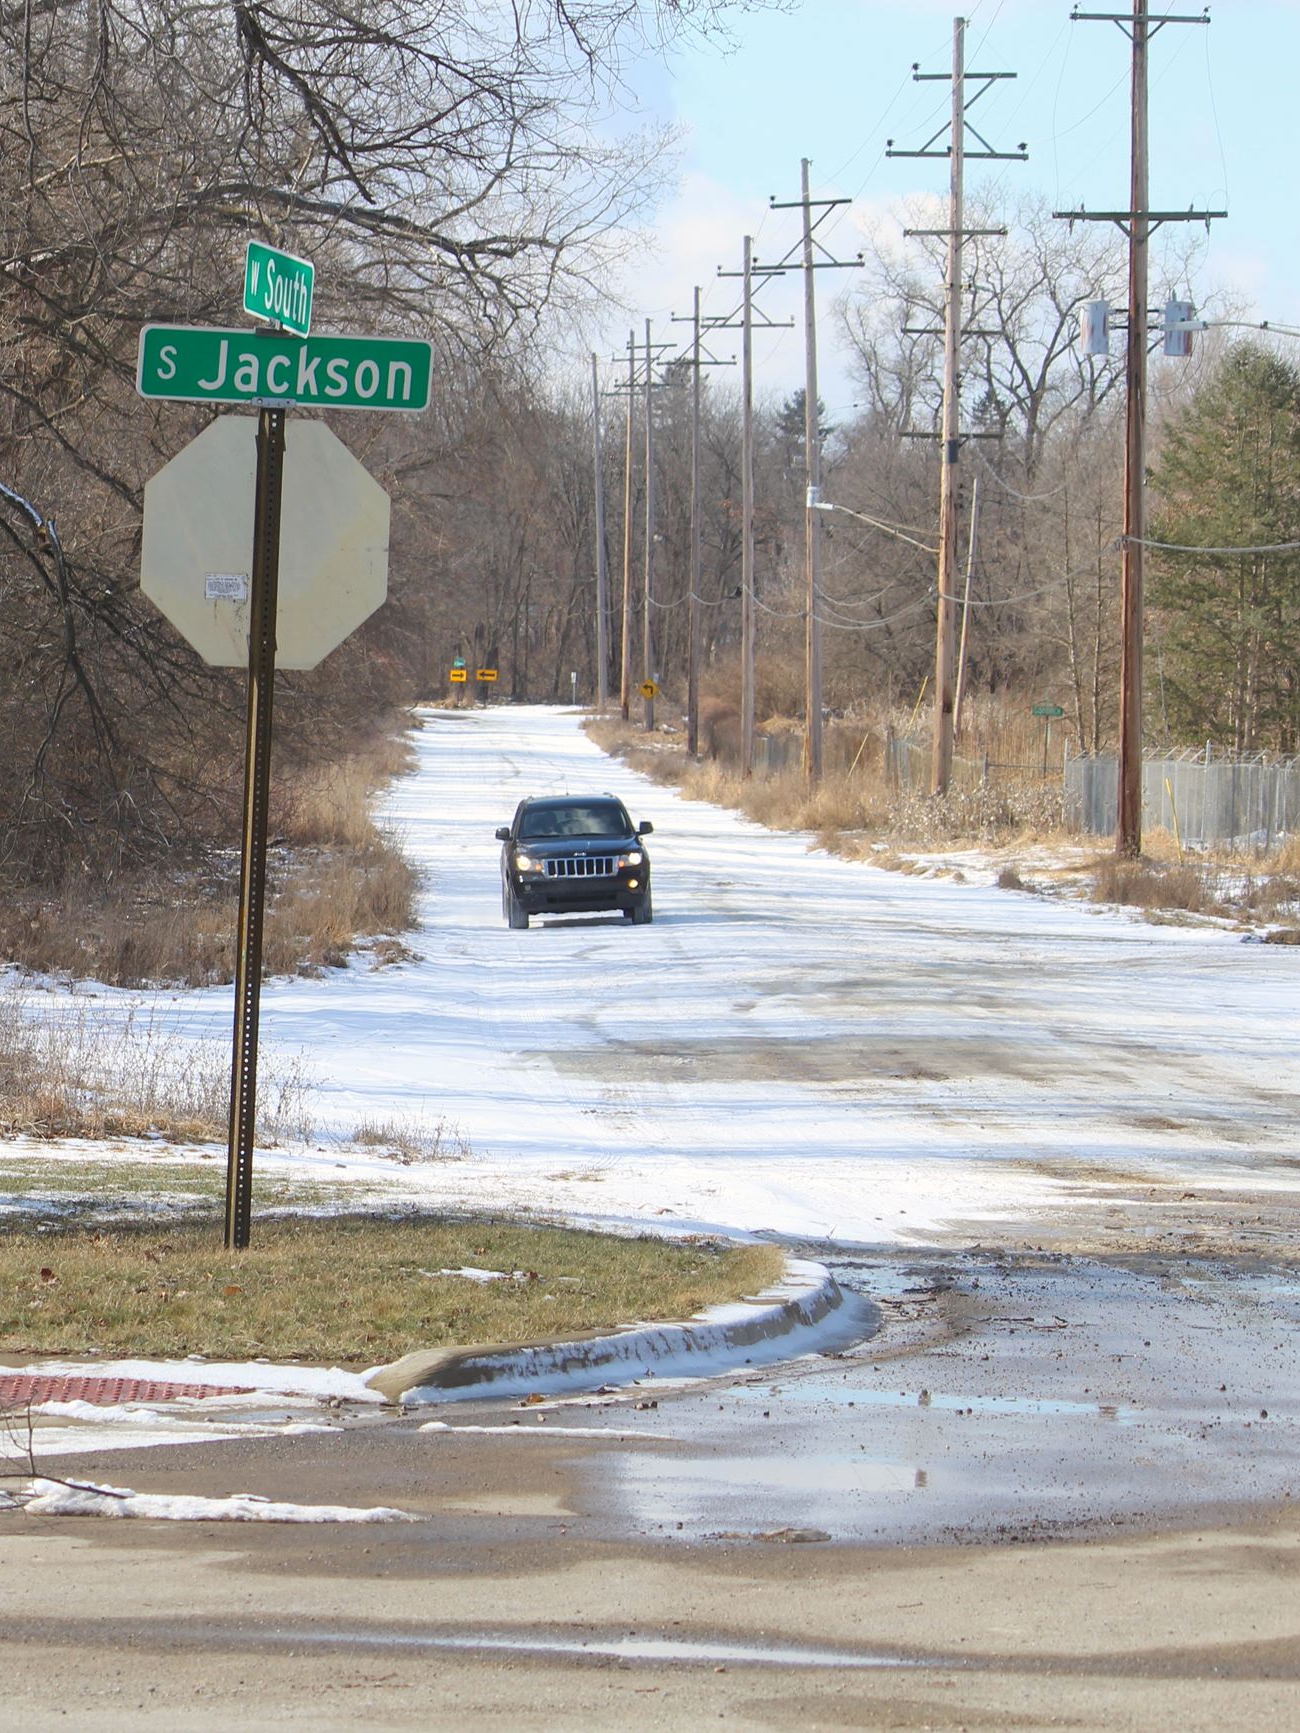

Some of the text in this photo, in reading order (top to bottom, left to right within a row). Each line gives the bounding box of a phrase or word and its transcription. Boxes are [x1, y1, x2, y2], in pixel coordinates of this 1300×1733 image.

[251, 258, 308, 325] W South
[157, 339, 413, 401] S Jackson
